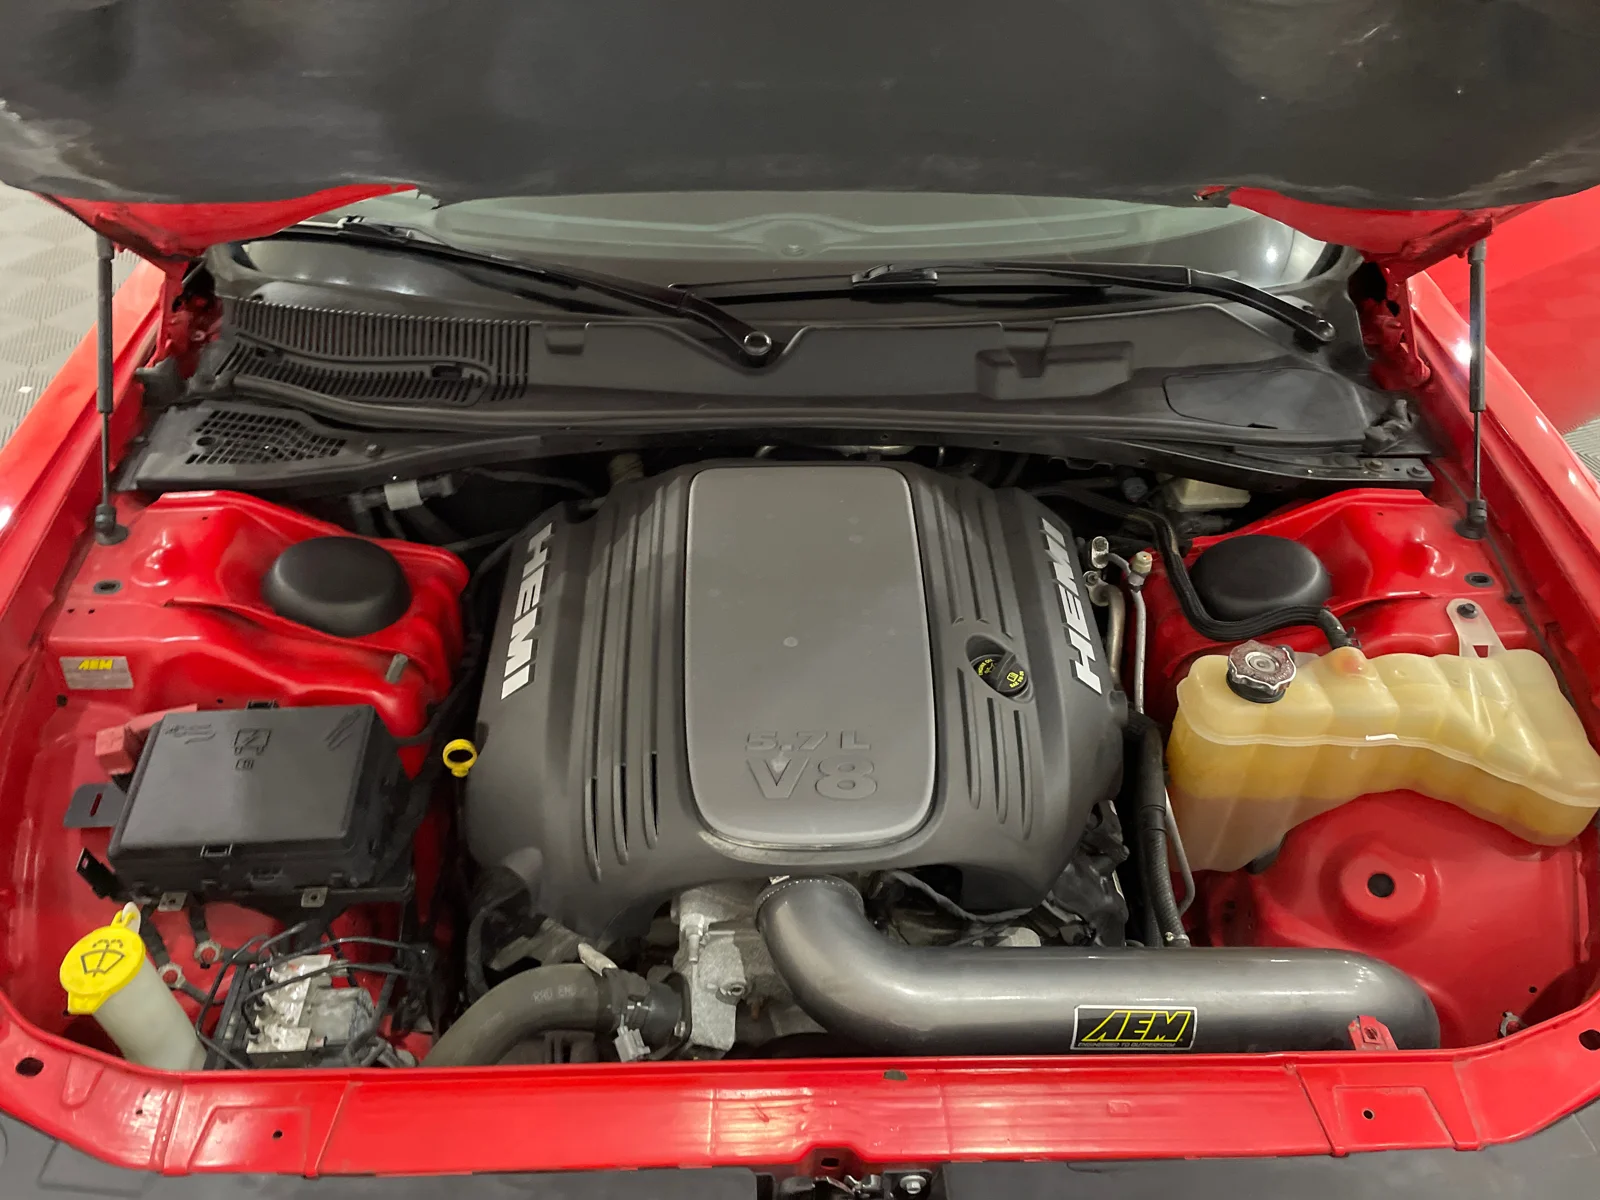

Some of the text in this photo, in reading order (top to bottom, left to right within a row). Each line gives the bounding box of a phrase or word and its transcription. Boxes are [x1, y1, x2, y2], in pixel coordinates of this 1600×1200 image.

[501, 522, 552, 700] HEMI
[1042, 517, 1102, 695] HEMI
[78, 658, 113, 671] AEM
[746, 753, 878, 801] V8
[1080, 1009, 1191, 1042] AEM
